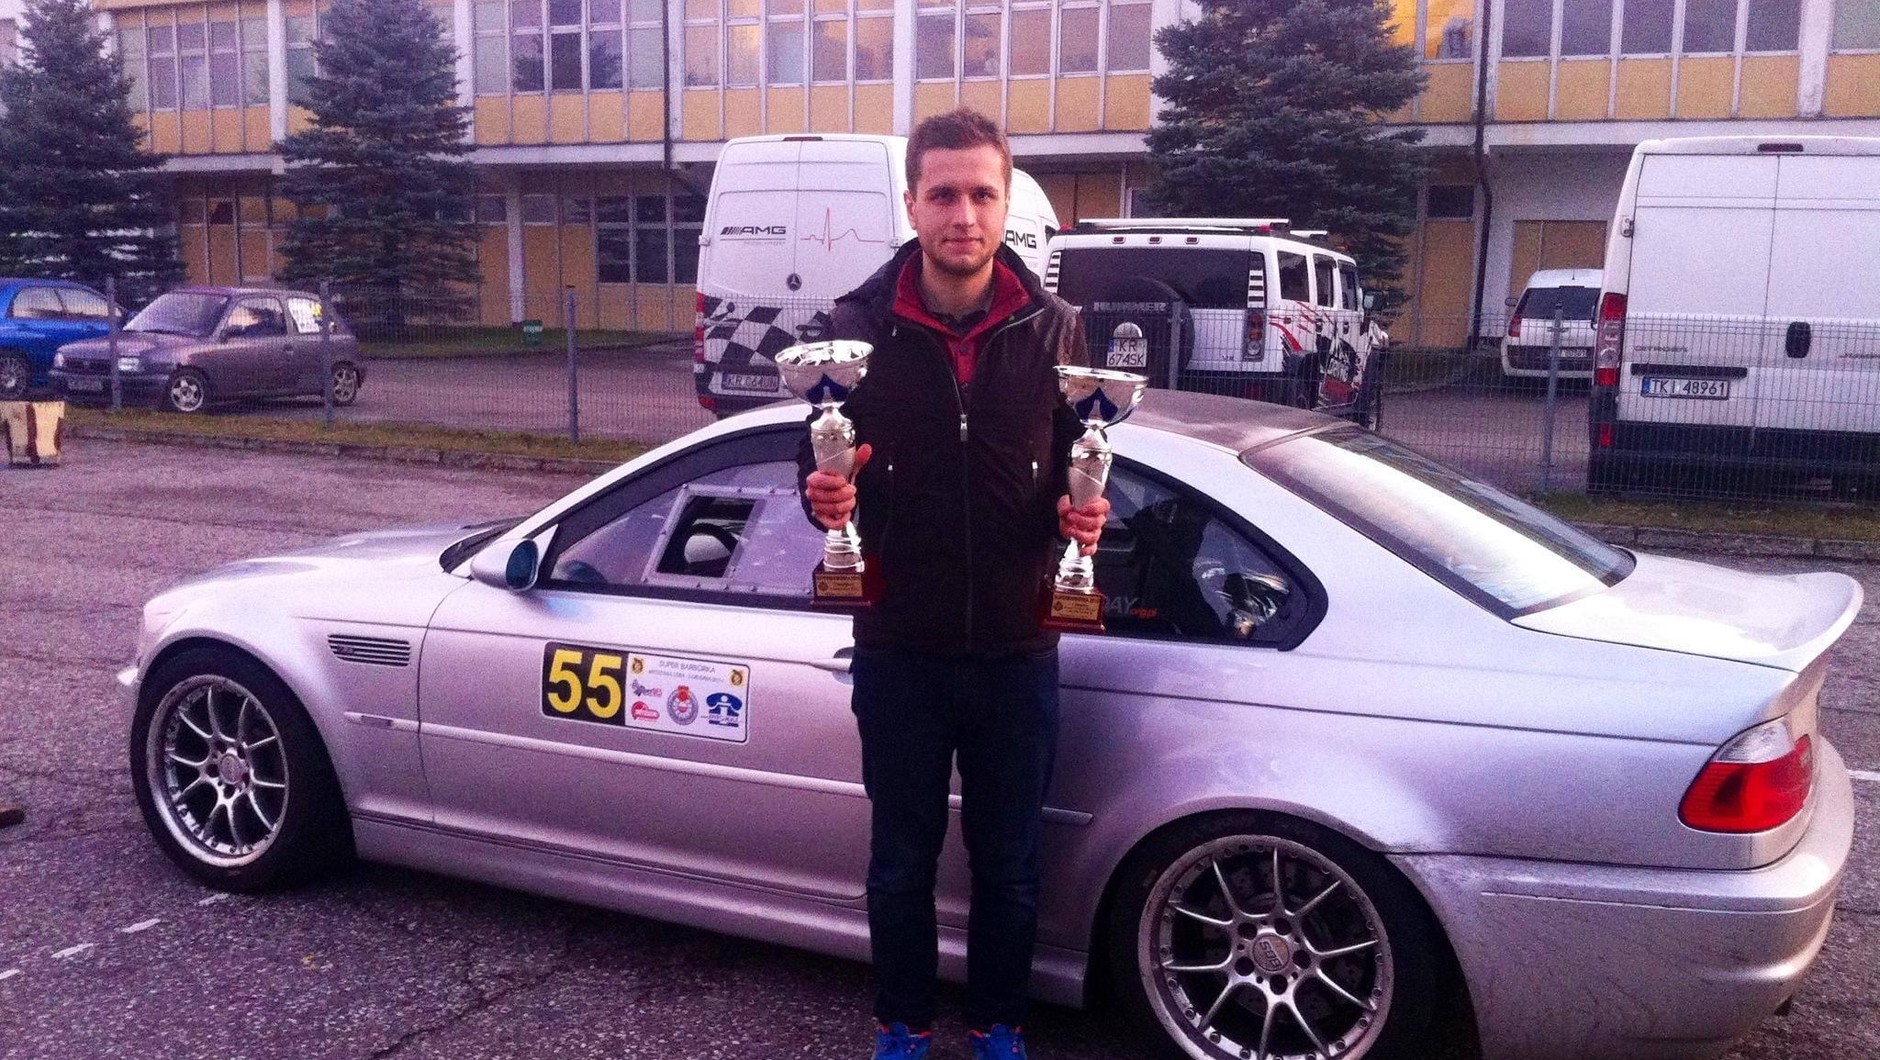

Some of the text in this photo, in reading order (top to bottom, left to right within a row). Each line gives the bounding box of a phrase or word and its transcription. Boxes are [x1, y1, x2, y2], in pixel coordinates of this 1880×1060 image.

[740, 226, 787, 236] AMG
[1005, 229, 1038, 250] AMG
[1118, 338, 1138, 352] KR
[1108, 352, 1145, 366] 674SK
[1652, 379, 1725, 396] TKI 48961
[547, 648, 623, 719] 55
